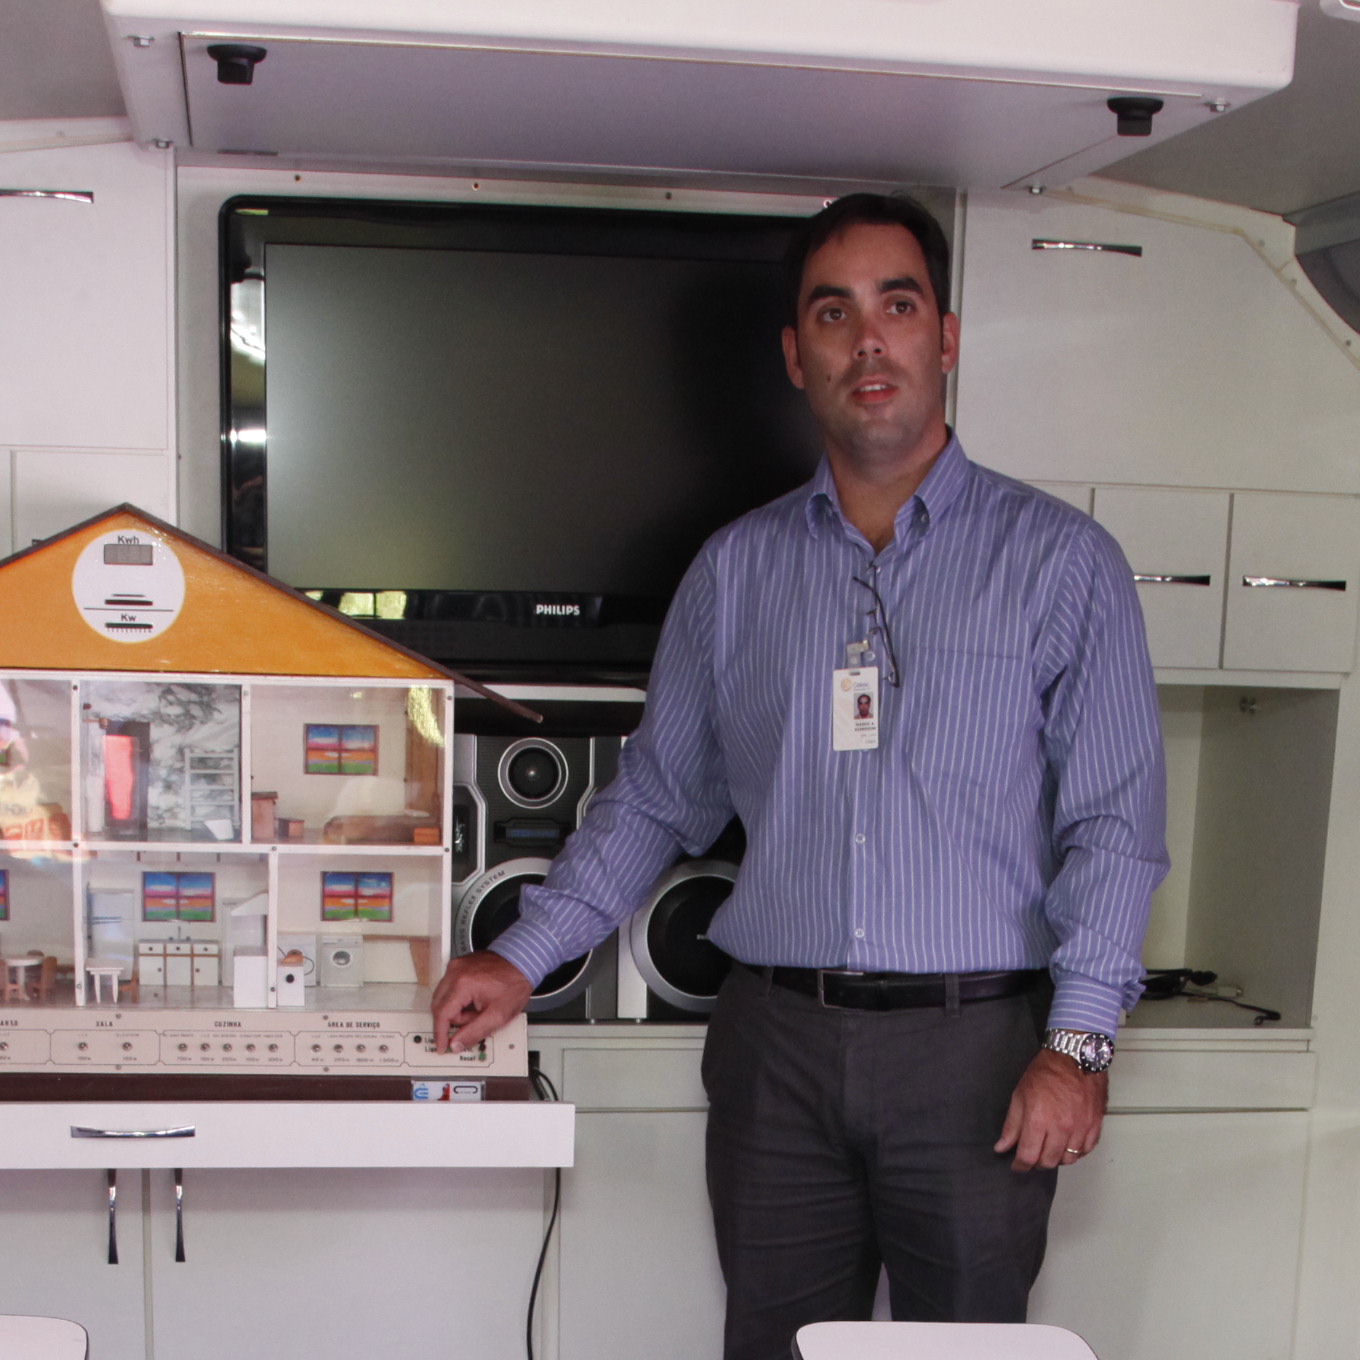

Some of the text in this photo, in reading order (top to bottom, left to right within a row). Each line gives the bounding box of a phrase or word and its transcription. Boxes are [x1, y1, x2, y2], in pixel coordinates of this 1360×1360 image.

[117, 535, 140, 544] Kwh
[536, 604, 580, 616] PHILIPS
[120, 613, 137, 622] Kw
[476, 870, 505, 894] SYSTEM
